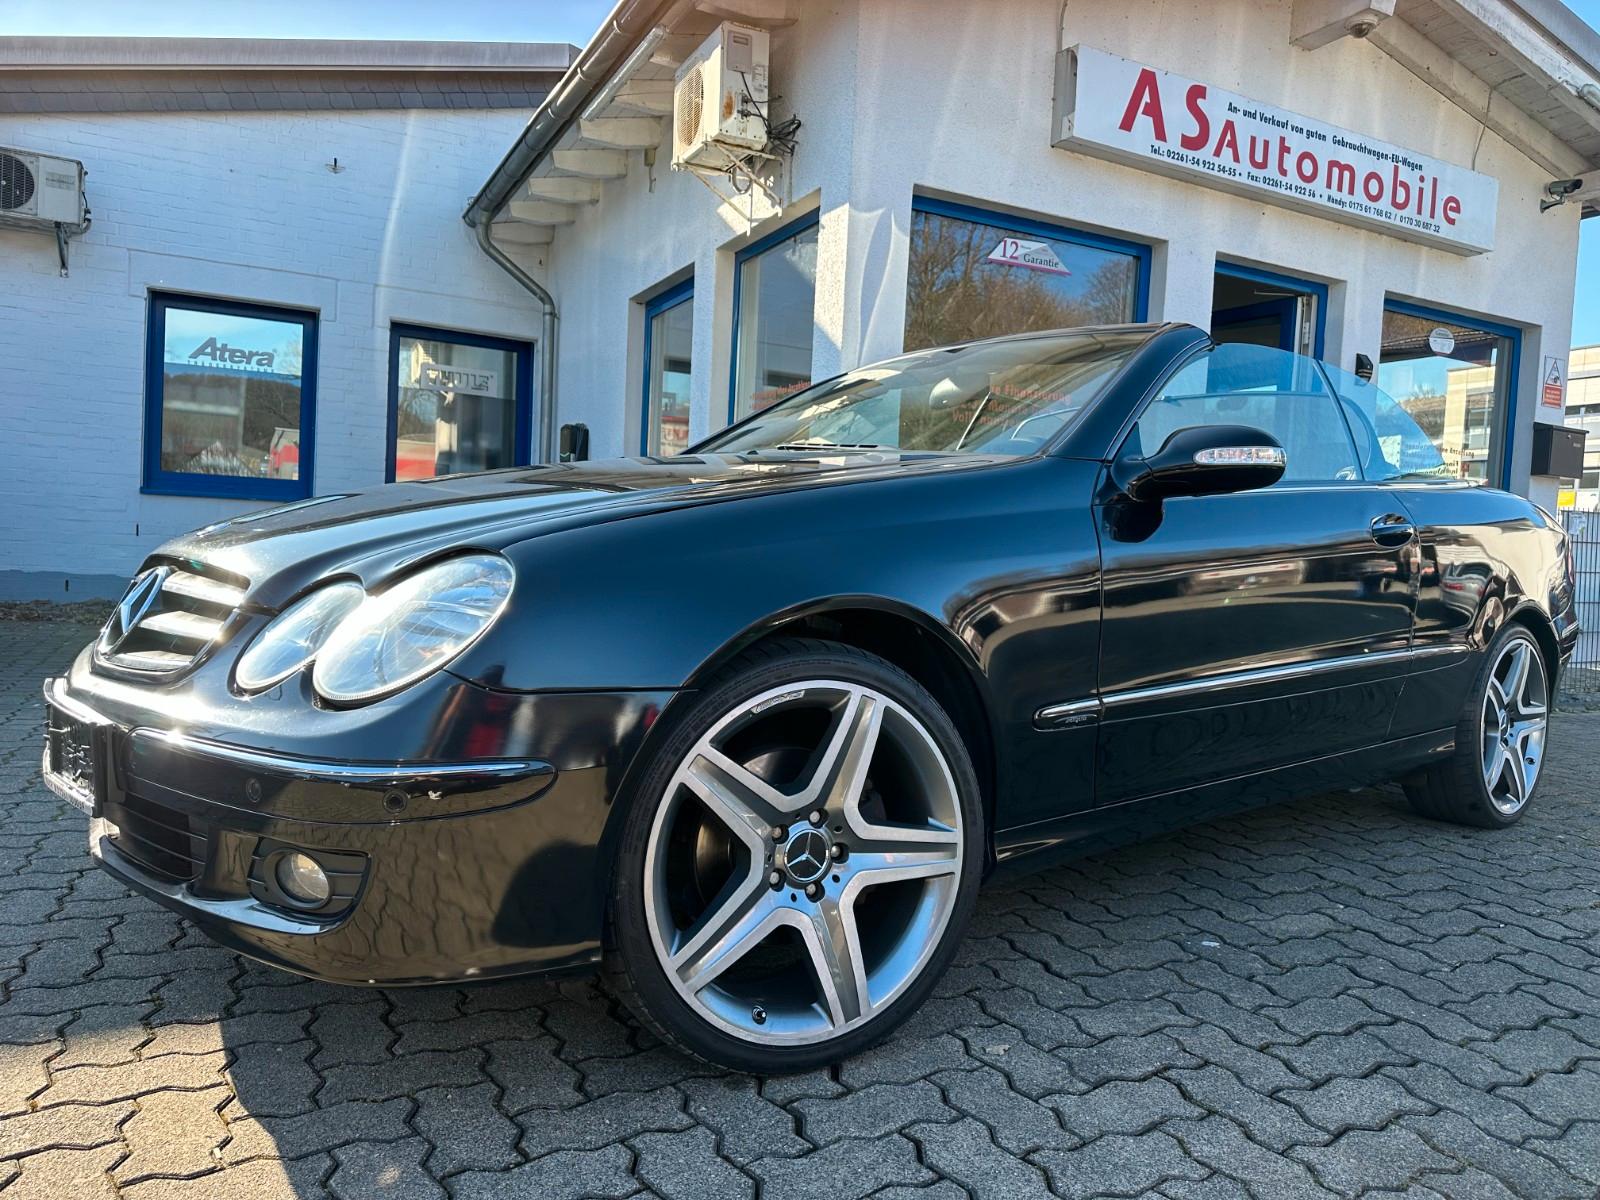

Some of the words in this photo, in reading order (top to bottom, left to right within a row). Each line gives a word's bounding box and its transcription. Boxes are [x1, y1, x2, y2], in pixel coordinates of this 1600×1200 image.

[1227, 102, 1241, 114] An-
[1242, 109, 1257, 121] und
[1259, 111, 1289, 130] Verkauf
[1290, 124, 1304, 135] von
[1305, 128, 1327, 141] guten
[1150, 144, 1165, 157] Tel.:
[1166, 149, 1200, 167] 02261-54
[1201, 159, 1216, 171] 922
[1216, 164, 1237, 177] 54-55
[1247, 172, 1261, 181] Fax:
[1262, 175, 1293, 192] 02261-54
[1294, 185, 1307, 196] 922
[1307, 189, 1316, 198] 56
[1327, 194, 1348, 208] Handy:
[1348, 200, 1364, 212] 0175
[1364, 204, 1371, 214] 61
[1384, 210, 1392, 220] 62
[1399, 215, 1414, 226] 0170
[1414, 218, 1421, 228] 30
[1432, 224, 1441, 233] 32
[1213, 119, 1462, 226] Automobile
[1000, 239, 1019, 260] 12
[1023, 253, 1060, 269] Garantie
[188, 336, 275, 368] Atera
